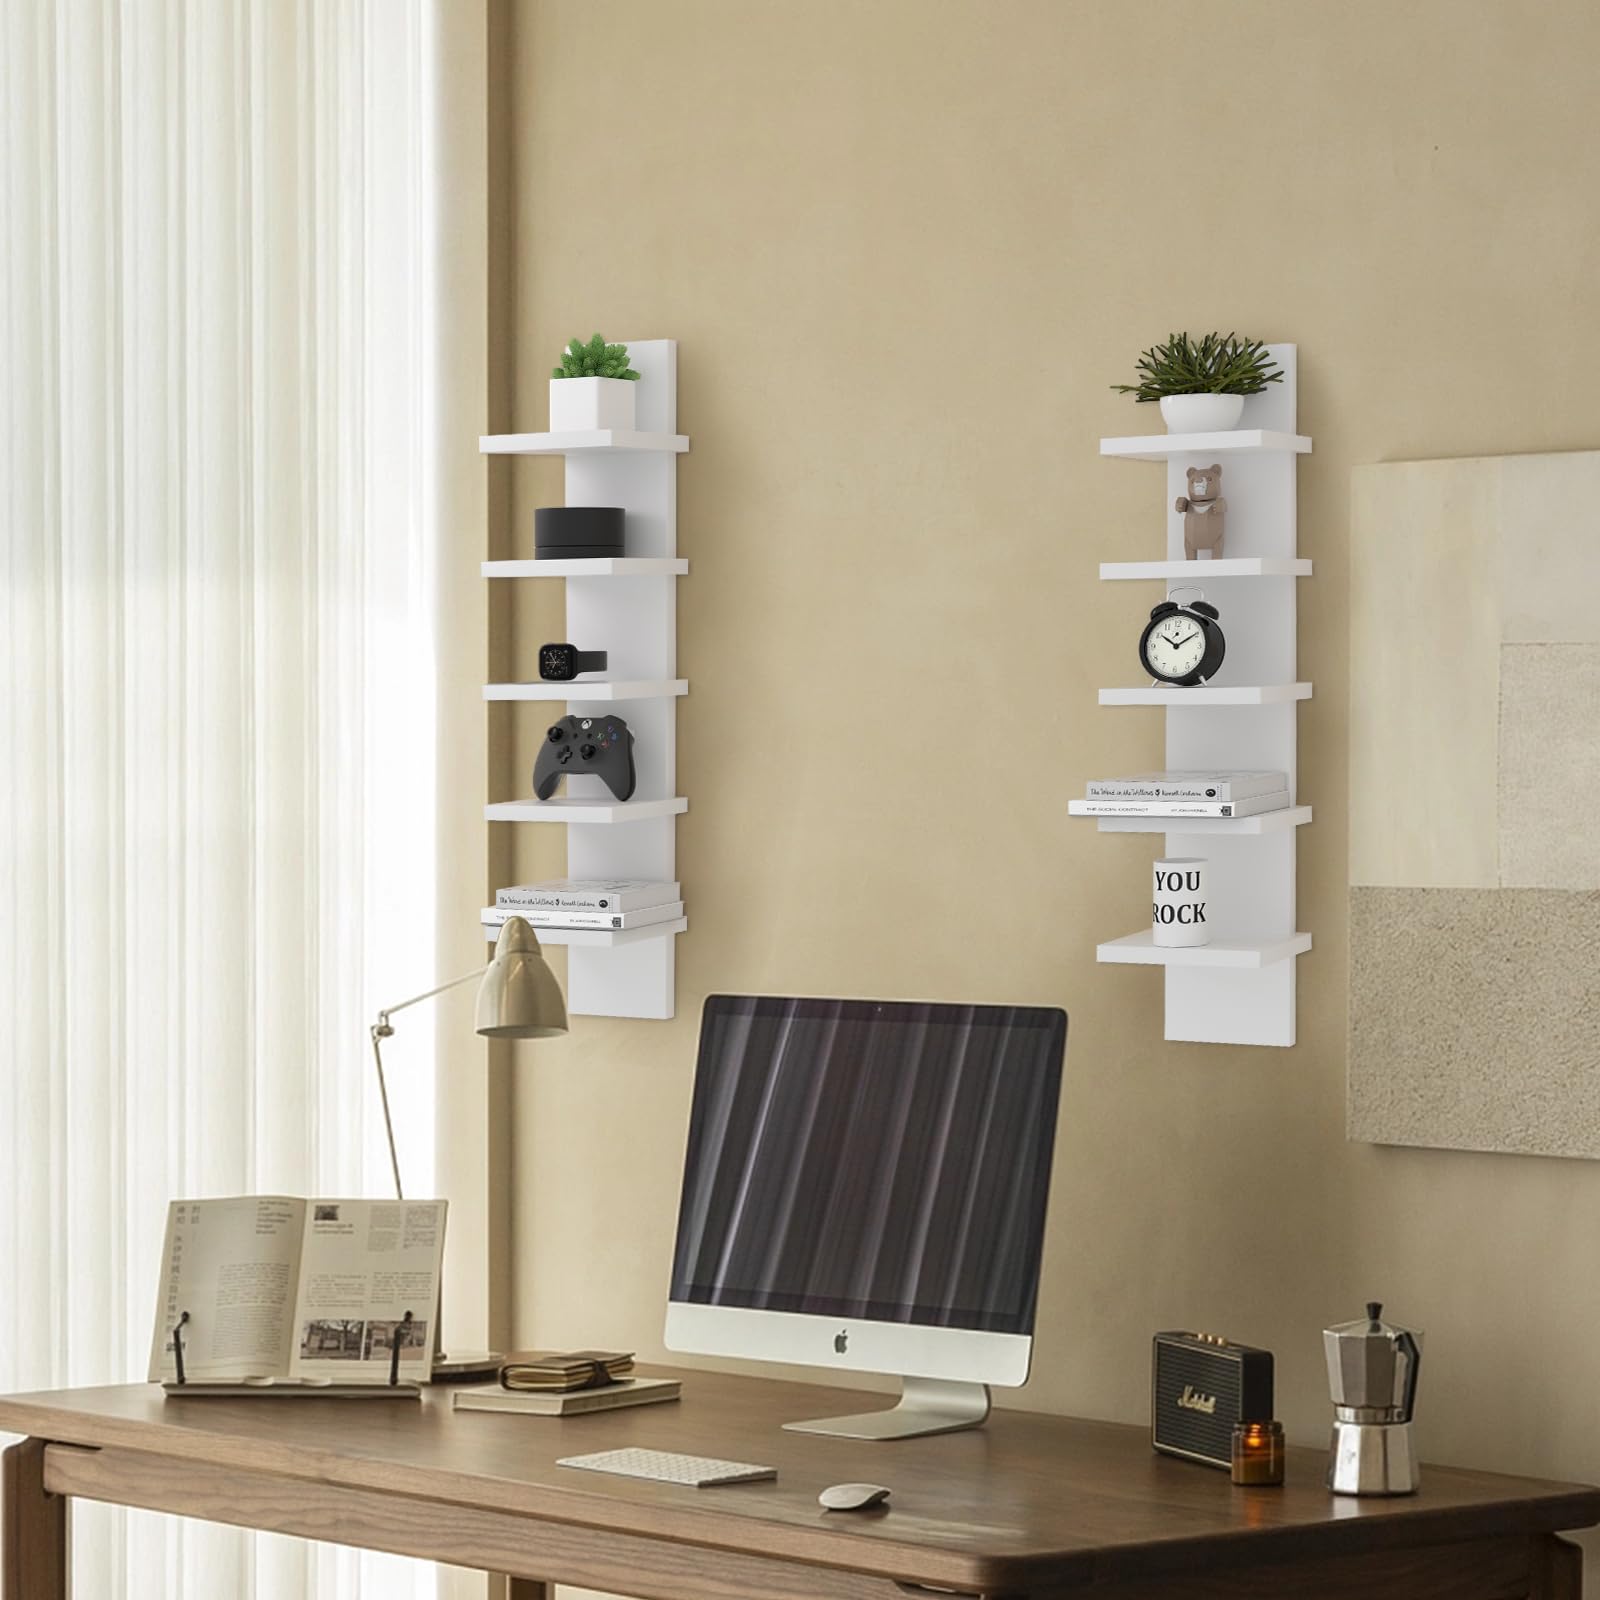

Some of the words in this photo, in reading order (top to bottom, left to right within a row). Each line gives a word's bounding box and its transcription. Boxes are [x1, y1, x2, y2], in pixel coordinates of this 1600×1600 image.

[1164, 623, 1171, 631] 11
[1175, 620, 1182, 628] 12
[1185, 661, 1190, 669] 5
[1155, 871, 1201, 892] YOU
[1152, 902, 1207, 925] ROCK
